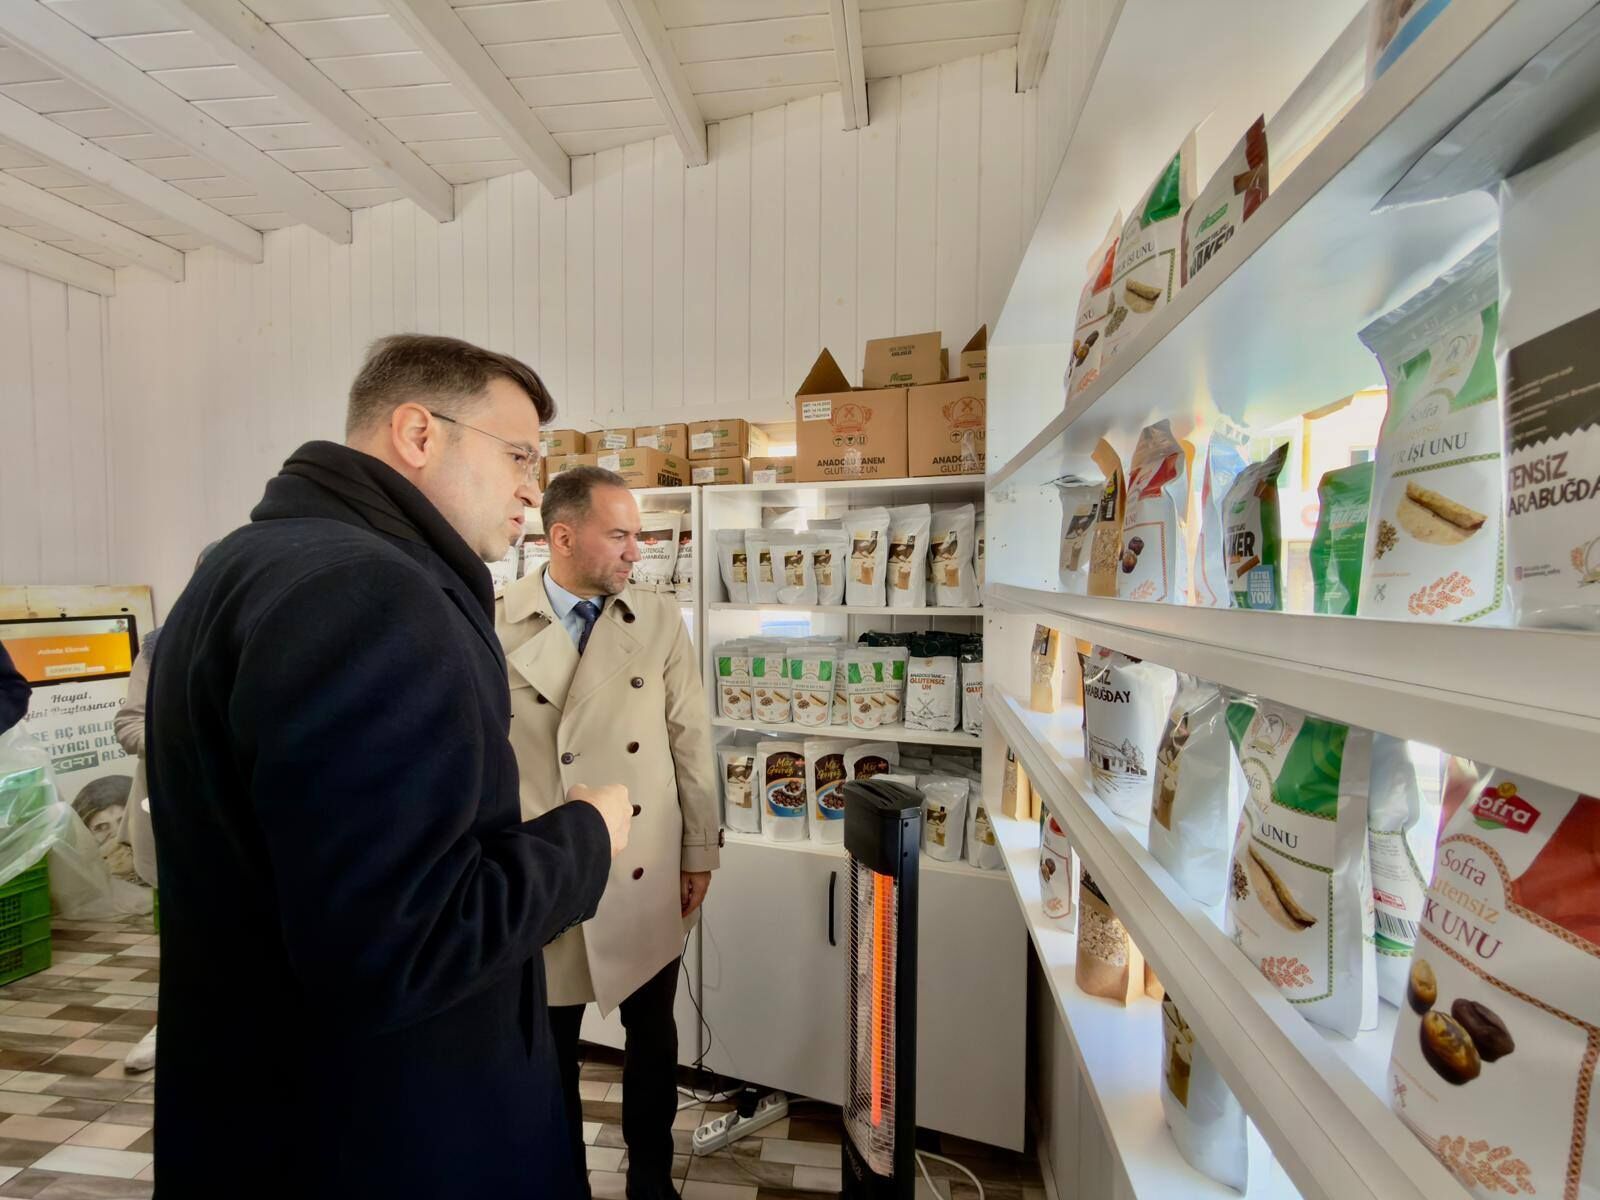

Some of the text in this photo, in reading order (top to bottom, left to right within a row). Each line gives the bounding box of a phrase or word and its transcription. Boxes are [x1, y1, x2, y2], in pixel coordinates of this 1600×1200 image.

[1429, 431, 1469, 456] UNU
[866, 465, 878, 474] UN
[1251, 592, 1272, 605] YOK
[55, 726, 74, 741] AÇ
[1261, 822, 1299, 850] UNU
[1441, 848, 1487, 887] Sofra
[1441, 908, 1503, 960] UNU
